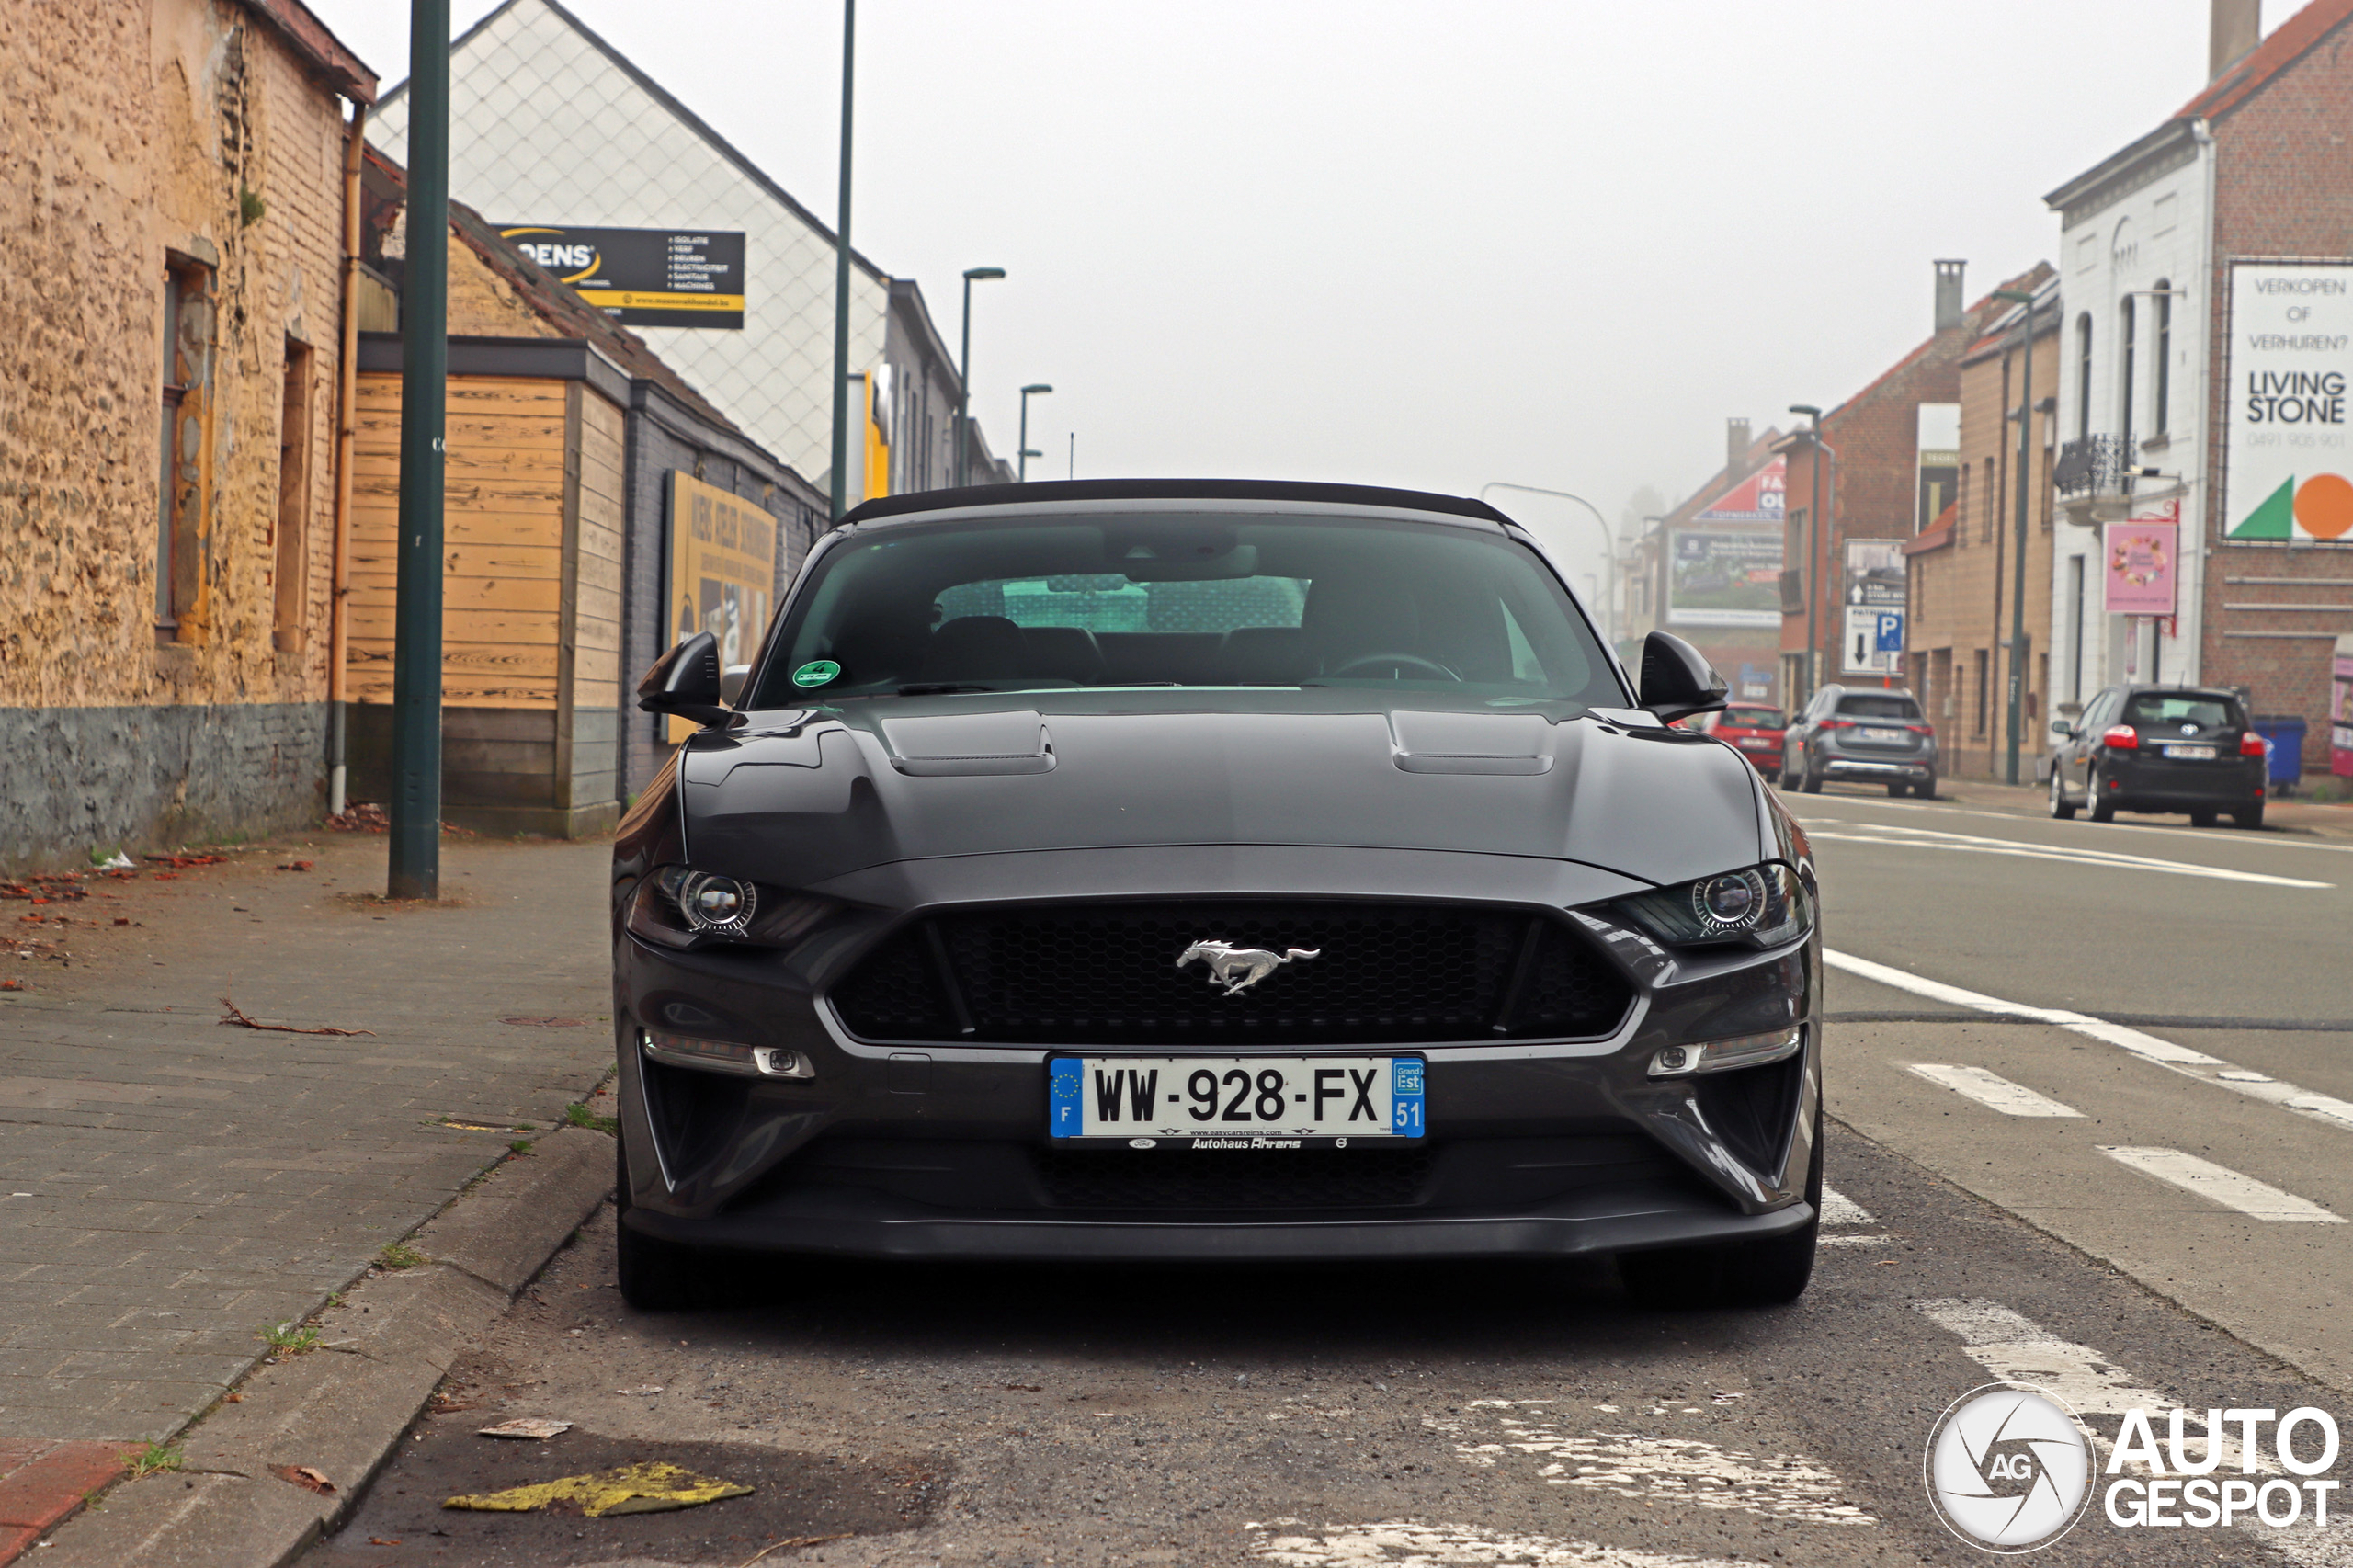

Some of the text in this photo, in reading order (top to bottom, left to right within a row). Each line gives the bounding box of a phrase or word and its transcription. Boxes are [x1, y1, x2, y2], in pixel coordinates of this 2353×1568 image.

[674, 281, 715, 292] MACHINES
[2255, 278, 2346, 295] VERKOPEN
[2286, 306, 2312, 322] OF
[2248, 334, 2348, 350] VERHUREN?
[2248, 371, 2347, 396] LIVING
[2247, 396, 2346, 424] STONE
[1881, 617, 1897, 637] P
[813, 662, 825, 673] 4
[1397, 1067, 1420, 1075] Grand
[1397, 1074, 1419, 1088] Est
[1095, 1069, 1377, 1121] WW-928-FX
[1062, 1107, 1071, 1121] F
[1396, 1102, 1420, 1127] 51
[1191, 1137, 1302, 1149] Autohaus Ahrens
